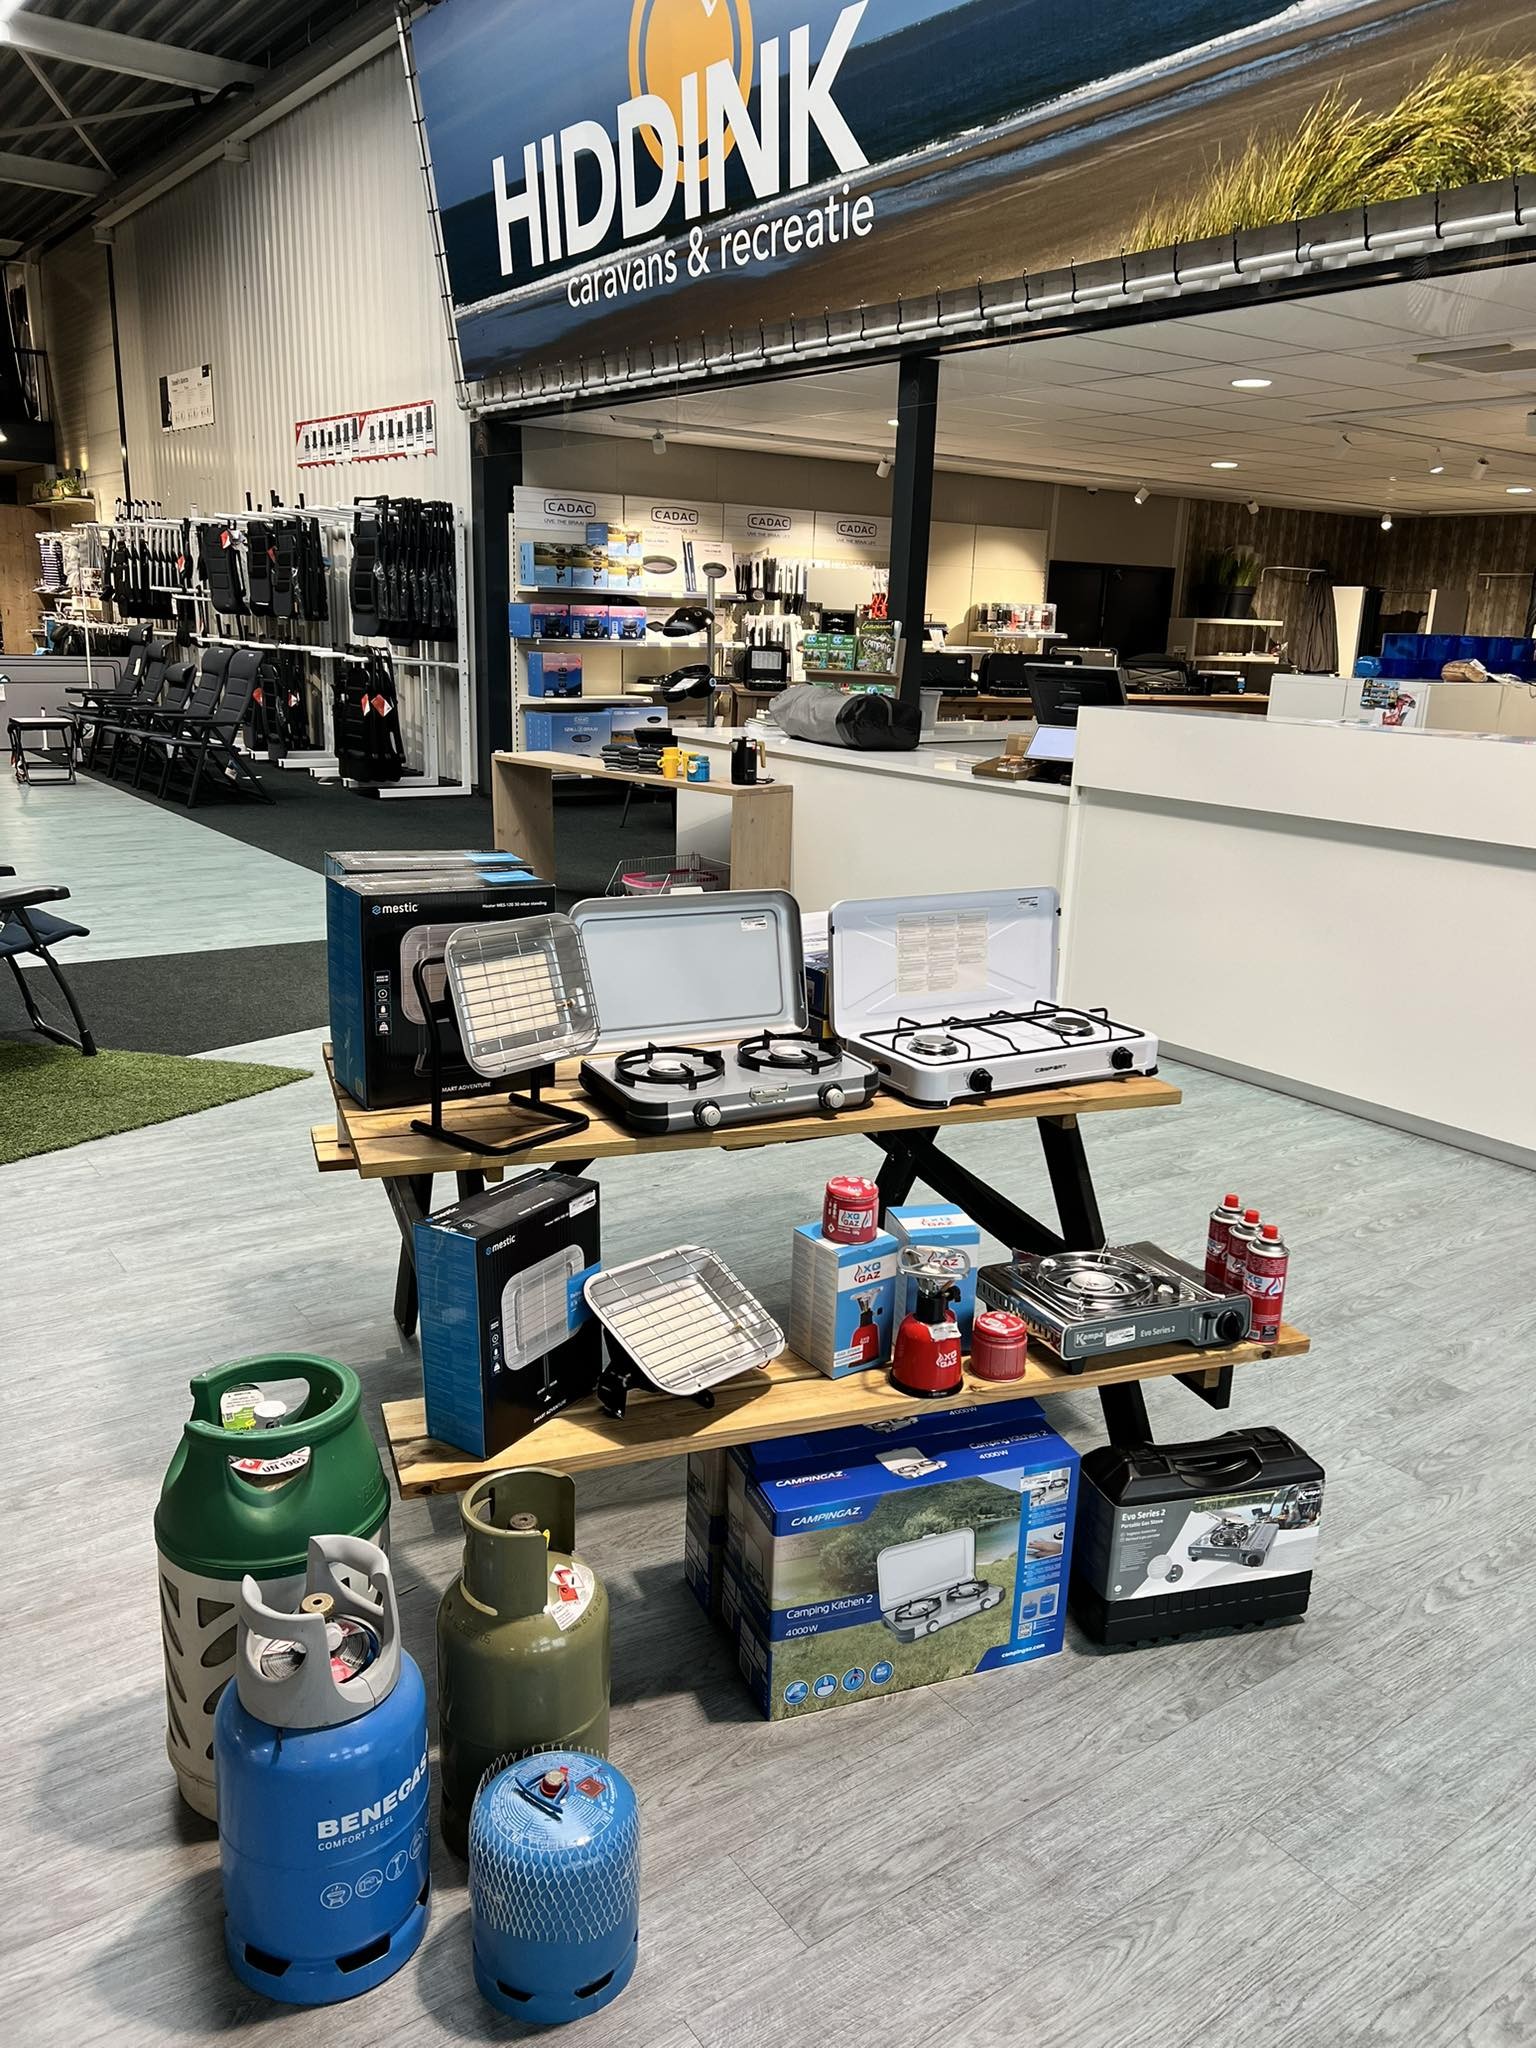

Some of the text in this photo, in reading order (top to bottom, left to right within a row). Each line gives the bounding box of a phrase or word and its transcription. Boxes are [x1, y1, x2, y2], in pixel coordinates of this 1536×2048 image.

[491, 0, 869, 277] HIDDINK
[566, 183, 875, 308] caravans & recreatie
[548, 502, 593, 515] CADAC
[655, 510, 696, 522] CADAC
[750, 516, 789, 528] CADAC
[839, 524, 875, 535] CADAC
[382, 902, 418, 914] mestic
[458, 1081, 491, 1091] ADVENTURE
[492, 1234, 516, 1253] mestic
[864, 1261, 881, 1274] XQ
[858, 1271, 881, 1284] GAZ
[1140, 1329, 1151, 1337] Evo
[1152, 1326, 1171, 1335] Series
[969, 1437, 1010, 1450] Camping
[979, 1449, 1009, 1460] 4000W
[261, 1463, 280, 1473] UN
[775, 1470, 844, 1488] CAMPINGAZ
[790, 1506, 861, 1527] CAMPINGAZ
[1121, 1508, 1167, 1522] Evo Series 2
[786, 1594, 874, 1620] Camping Kitchen 2
[317, 1751, 428, 1840] BENEGAS
[317, 1815, 394, 1852] COMFORT STEEL
